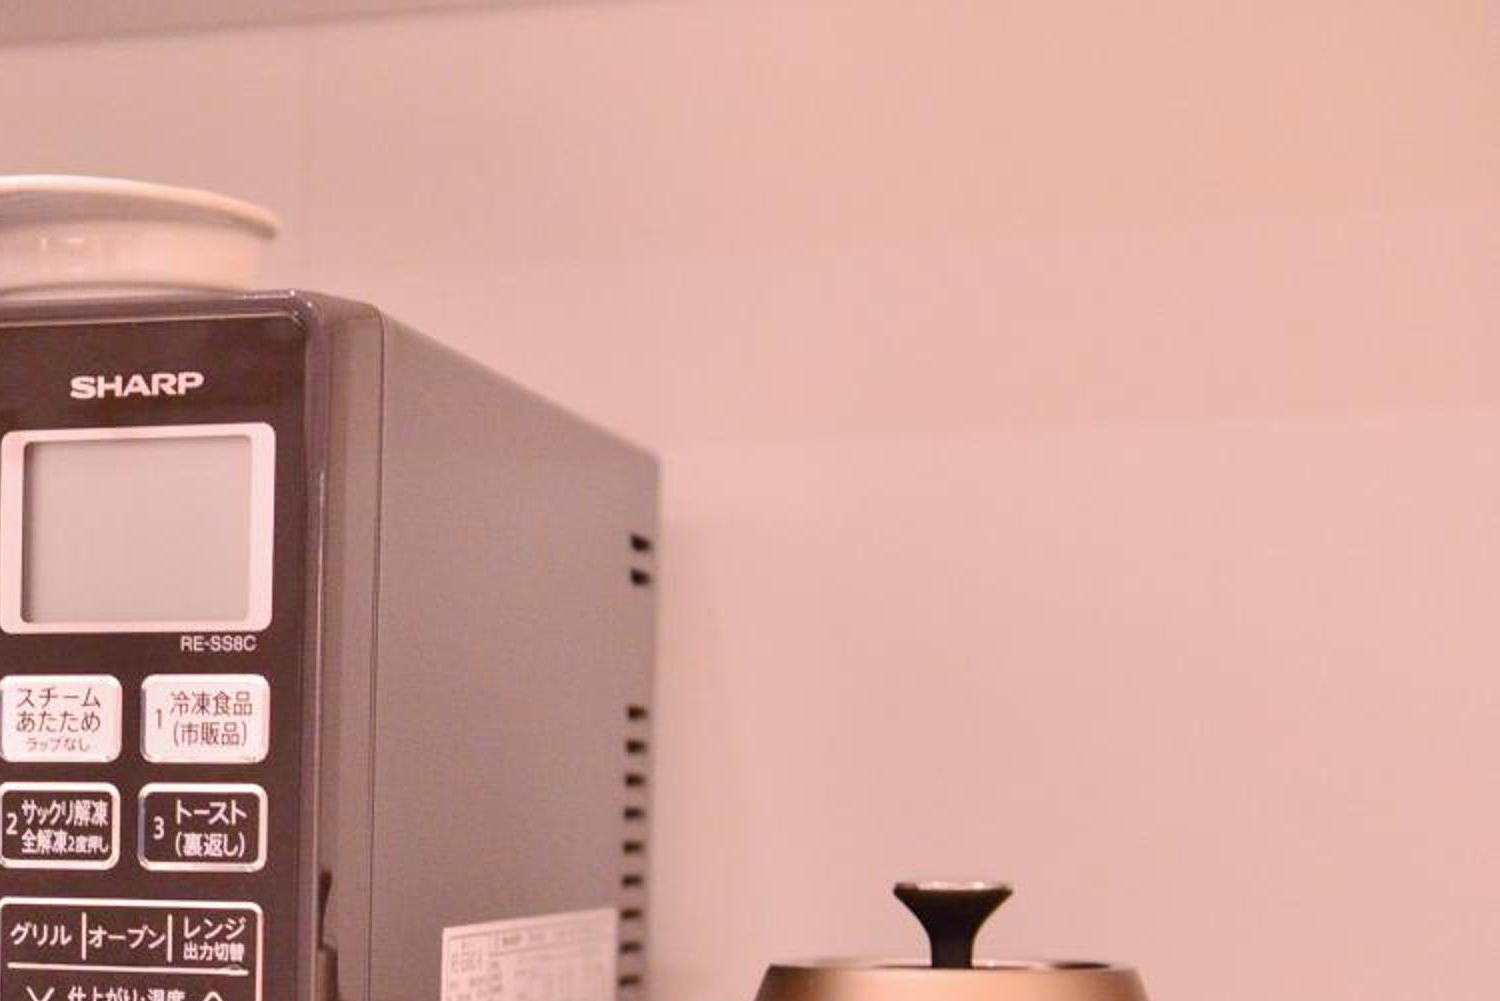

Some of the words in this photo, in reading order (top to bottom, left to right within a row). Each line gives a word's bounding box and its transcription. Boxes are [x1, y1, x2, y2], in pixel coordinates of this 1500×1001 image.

[70, 372, 204, 399] SHARP
[181, 636, 257, 652] RE-SS8C
[17, 687, 101, 709] スチーム
[170, 691, 253, 717] 冷凍食品
[16, 710, 101, 733] あたため
[25, 736, 92, 752] ラップなし
[173, 721, 248, 747] (市販品)
[5, 813, 19, 835] 2
[21, 799, 109, 827] サックリ解凍
[174, 799, 247, 826] トースト
[153, 816, 165, 839] 3
[174, 831, 246, 858] (裏返し)
[10, 921, 72, 947] グリル
[88, 925, 166, 949] オーブン
[183, 916, 247, 940] レンジ
[183, 942, 245, 963] 出力切替
